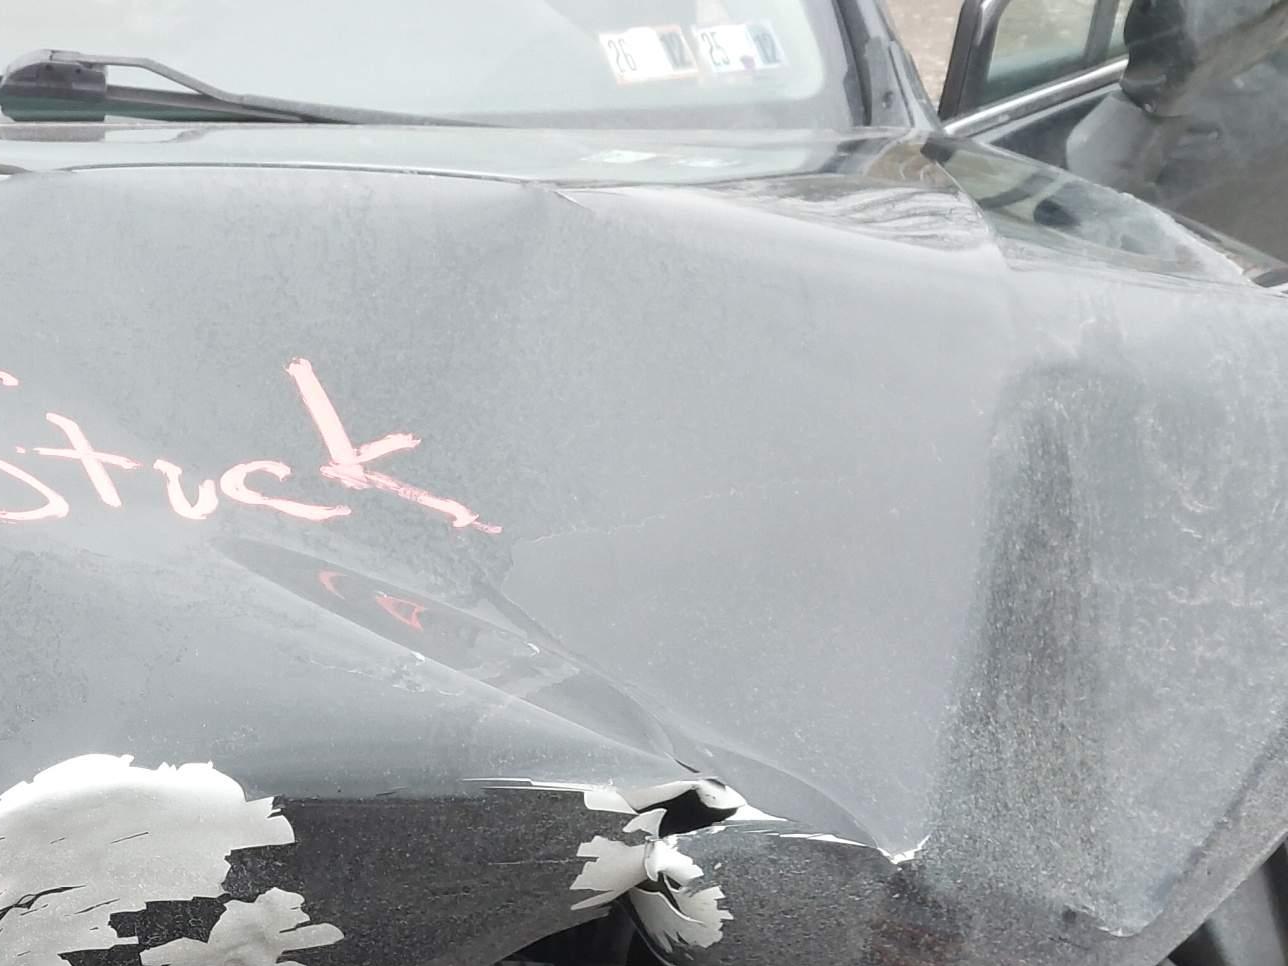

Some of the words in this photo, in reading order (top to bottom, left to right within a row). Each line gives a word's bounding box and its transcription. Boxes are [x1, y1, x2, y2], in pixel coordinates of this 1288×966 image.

[607, 38, 637, 72] 26
[701, 32, 730, 66] 25
[754, 32, 781, 64] 12
